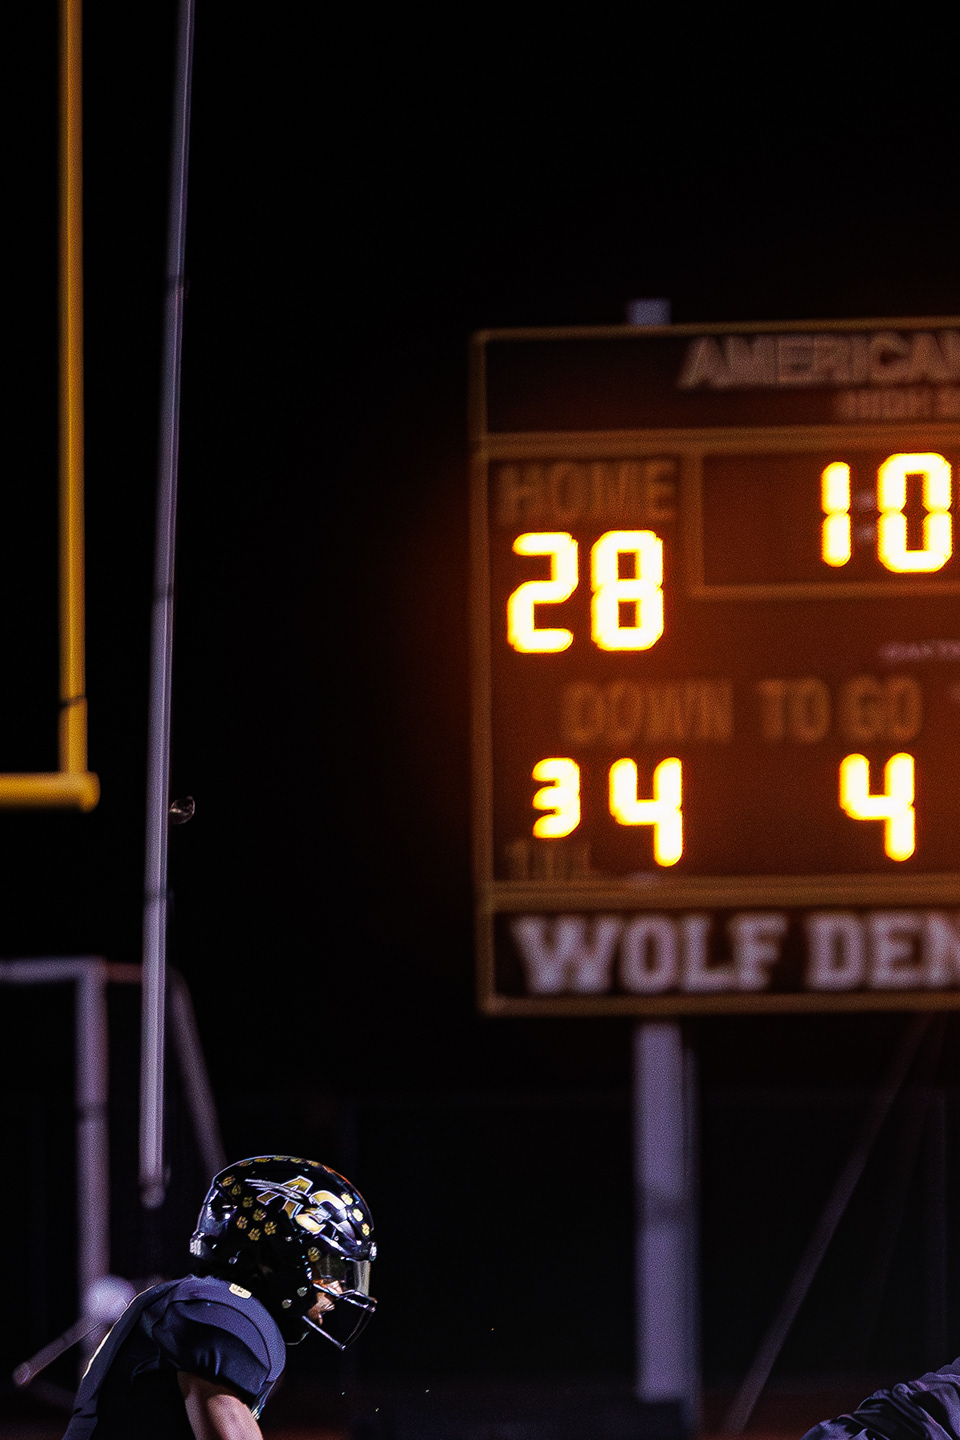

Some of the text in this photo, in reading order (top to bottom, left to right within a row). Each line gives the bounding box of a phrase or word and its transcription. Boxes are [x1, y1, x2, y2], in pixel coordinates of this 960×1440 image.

[503, 460, 677, 525] HOME
[507, 530, 663, 653] 28
[562, 680, 735, 748] DOWN
[532, 757, 580, 839] 3
[609, 757, 683, 866] 4
[839, 752, 915, 862] 4
[511, 913, 787, 994] WOLF
